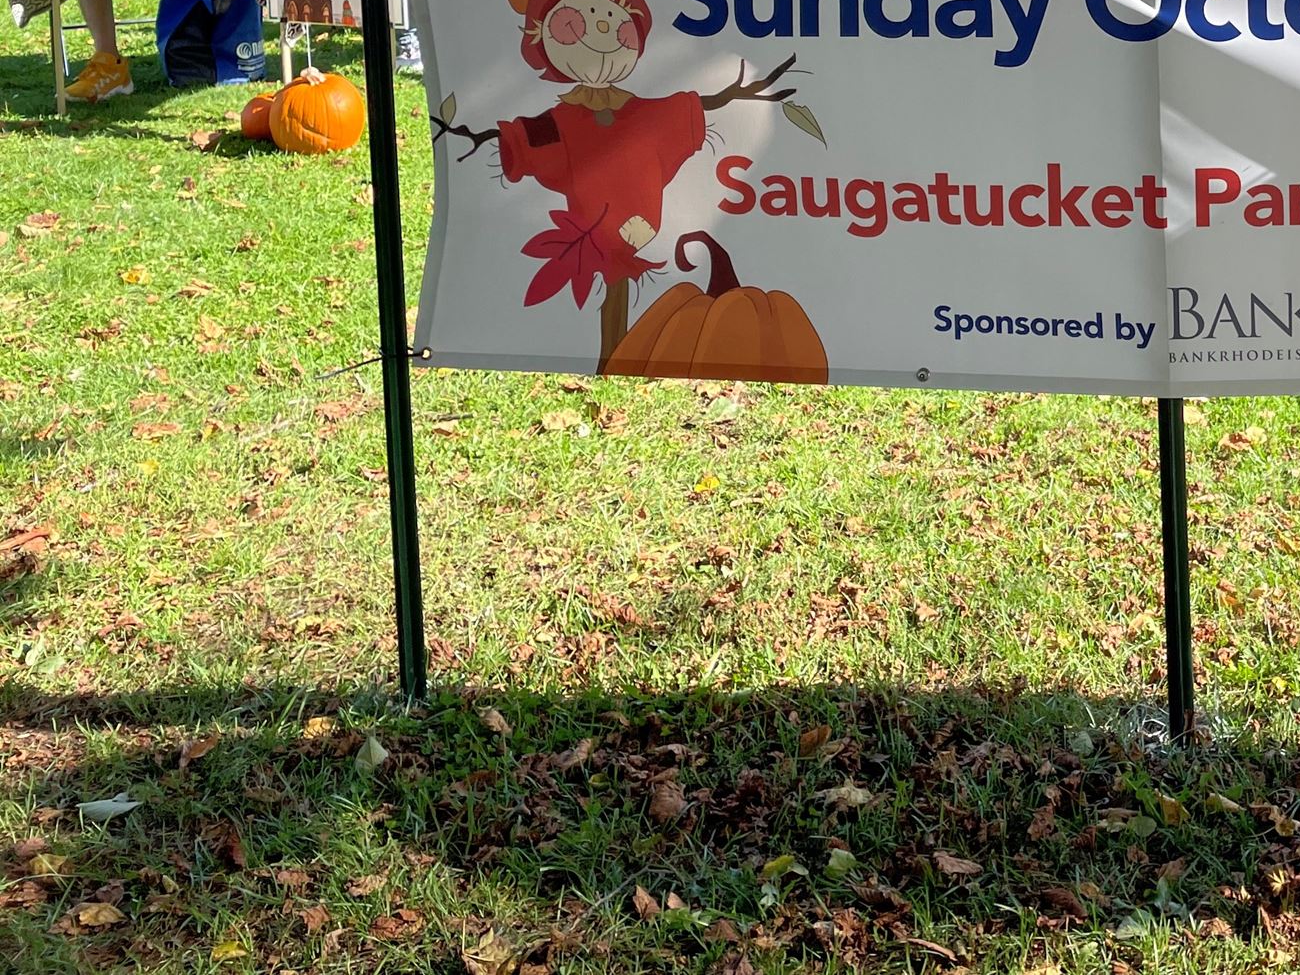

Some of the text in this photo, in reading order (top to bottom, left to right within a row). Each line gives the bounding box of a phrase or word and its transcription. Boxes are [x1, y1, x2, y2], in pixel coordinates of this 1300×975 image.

[714, 155, 1168, 238] Saugatucket
[932, 305, 1156, 349] Sponsored by
